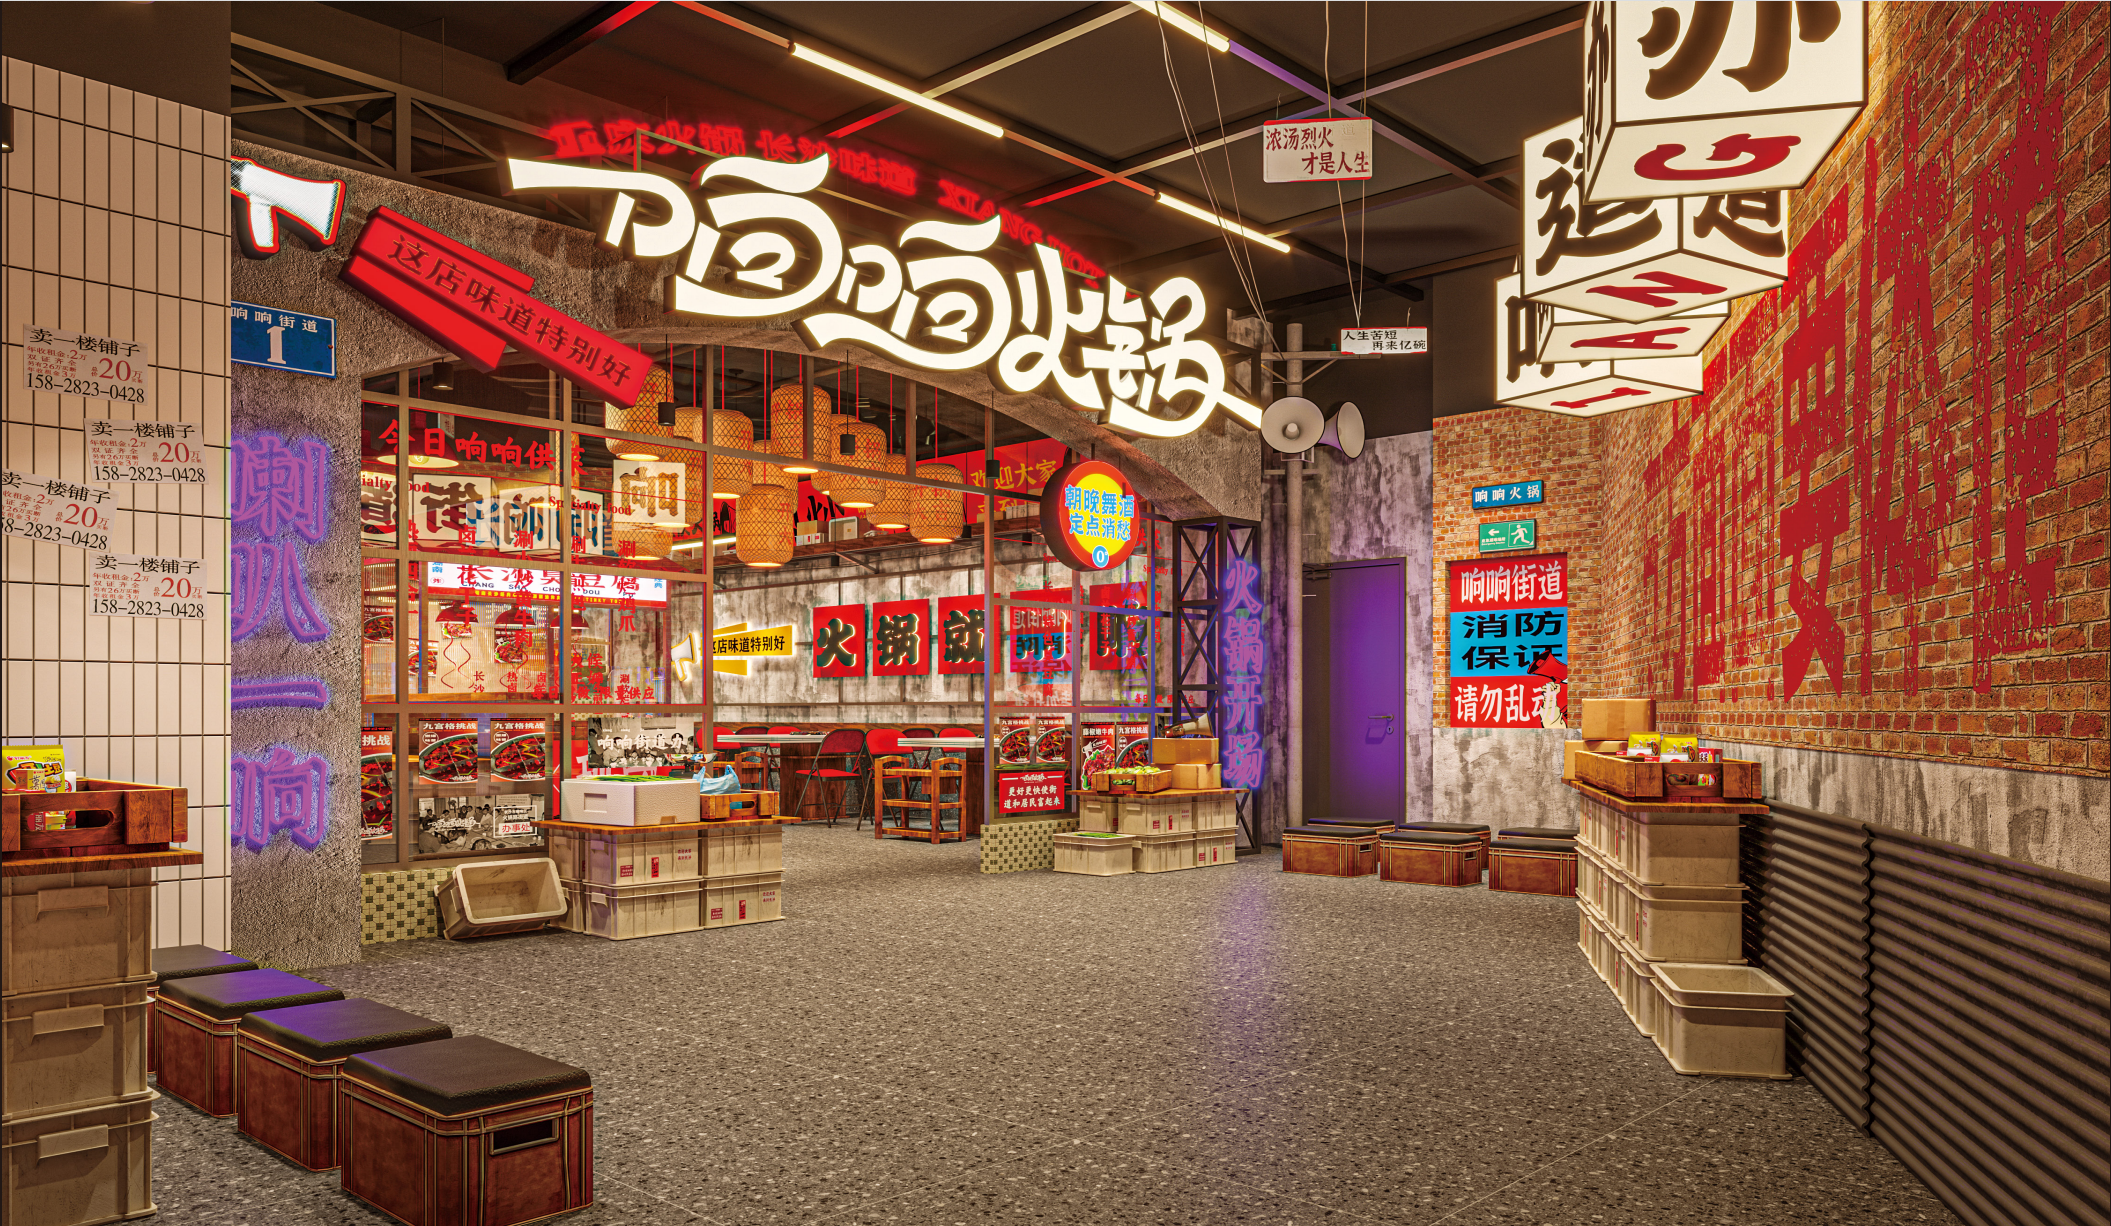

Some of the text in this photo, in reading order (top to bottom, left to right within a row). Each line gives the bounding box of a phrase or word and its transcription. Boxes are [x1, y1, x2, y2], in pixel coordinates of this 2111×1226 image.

[1266, 127, 1334, 151] 浓汤烈火
[1301, 151, 1370, 175] 才是人生
[937, 179, 1043, 245] XIANG
[387, 234, 632, 388] 这店味道特别好
[30, 328, 141, 357] 卖一楼铺子
[266, 326, 287, 365] 1
[1343, 330, 1398, 341] 人生苦短
[1372, 340, 1427, 351] 再来亿碗
[27, 372, 145, 403] 158-2823-0428
[91, 421, 195, 439] 卖一楼铺子
[94, 465, 206, 482] 158-2823-0428
[970, 459, 1057, 490] 欢迎大家
[2, 471, 111, 504] 卖一楼铺子
[1474, 484, 1540, 503] 响响火锅
[549, 496, 632, 516] Spcialty food
[1065, 484, 1134, 518] 朝晚舞酒
[2, 517, 108, 550] 8-2823-0428
[1069, 513, 1131, 541] 定点消愁
[95, 555, 200, 574] 卖一楼铺子
[543, 586, 561, 594] CHO
[1460, 560, 1563, 604] 响响街道
[92, 599, 204, 618] 158-2823-0428
[1462, 611, 1564, 639] 消防
[231, 435, 331, 846] 喇叭一响
[711, 635, 786, 655] 这店味道特别好
[1461, 644, 1563, 671] 保证
[1223, 560, 1264, 789] 火锅开场
[532, 683, 656, 701] 每日做限量供应
[1454, 683, 1556, 723] 请勿乱动
[423, 722, 477, 730] 九宫格挑战
[494, 722, 545, 730] 九宫格挑战
[1118, 726, 1149, 735] 九宫格挑战
[1003, 796, 1061, 809] 道和居民富起来
[501, 823, 531, 834] 办事处
